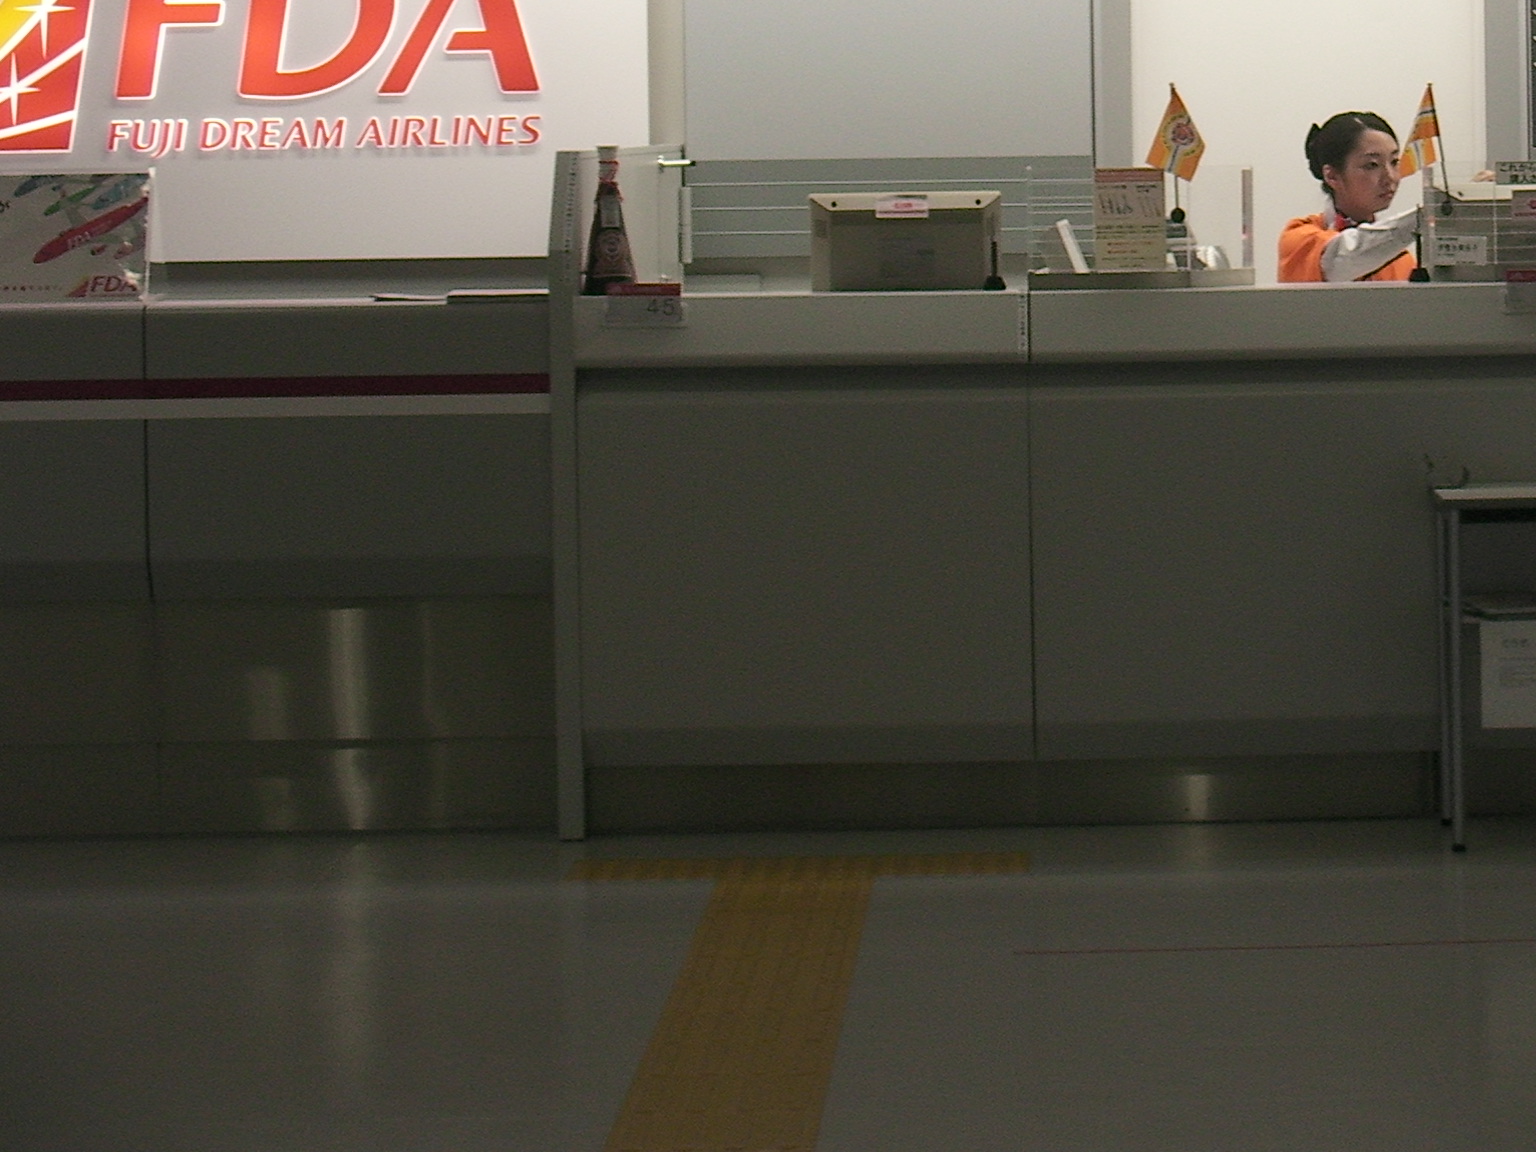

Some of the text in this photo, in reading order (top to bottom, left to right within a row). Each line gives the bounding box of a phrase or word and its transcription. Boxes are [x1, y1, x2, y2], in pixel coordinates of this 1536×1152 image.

[107, 114, 543, 159] FUJI DREAM AIRLINES
